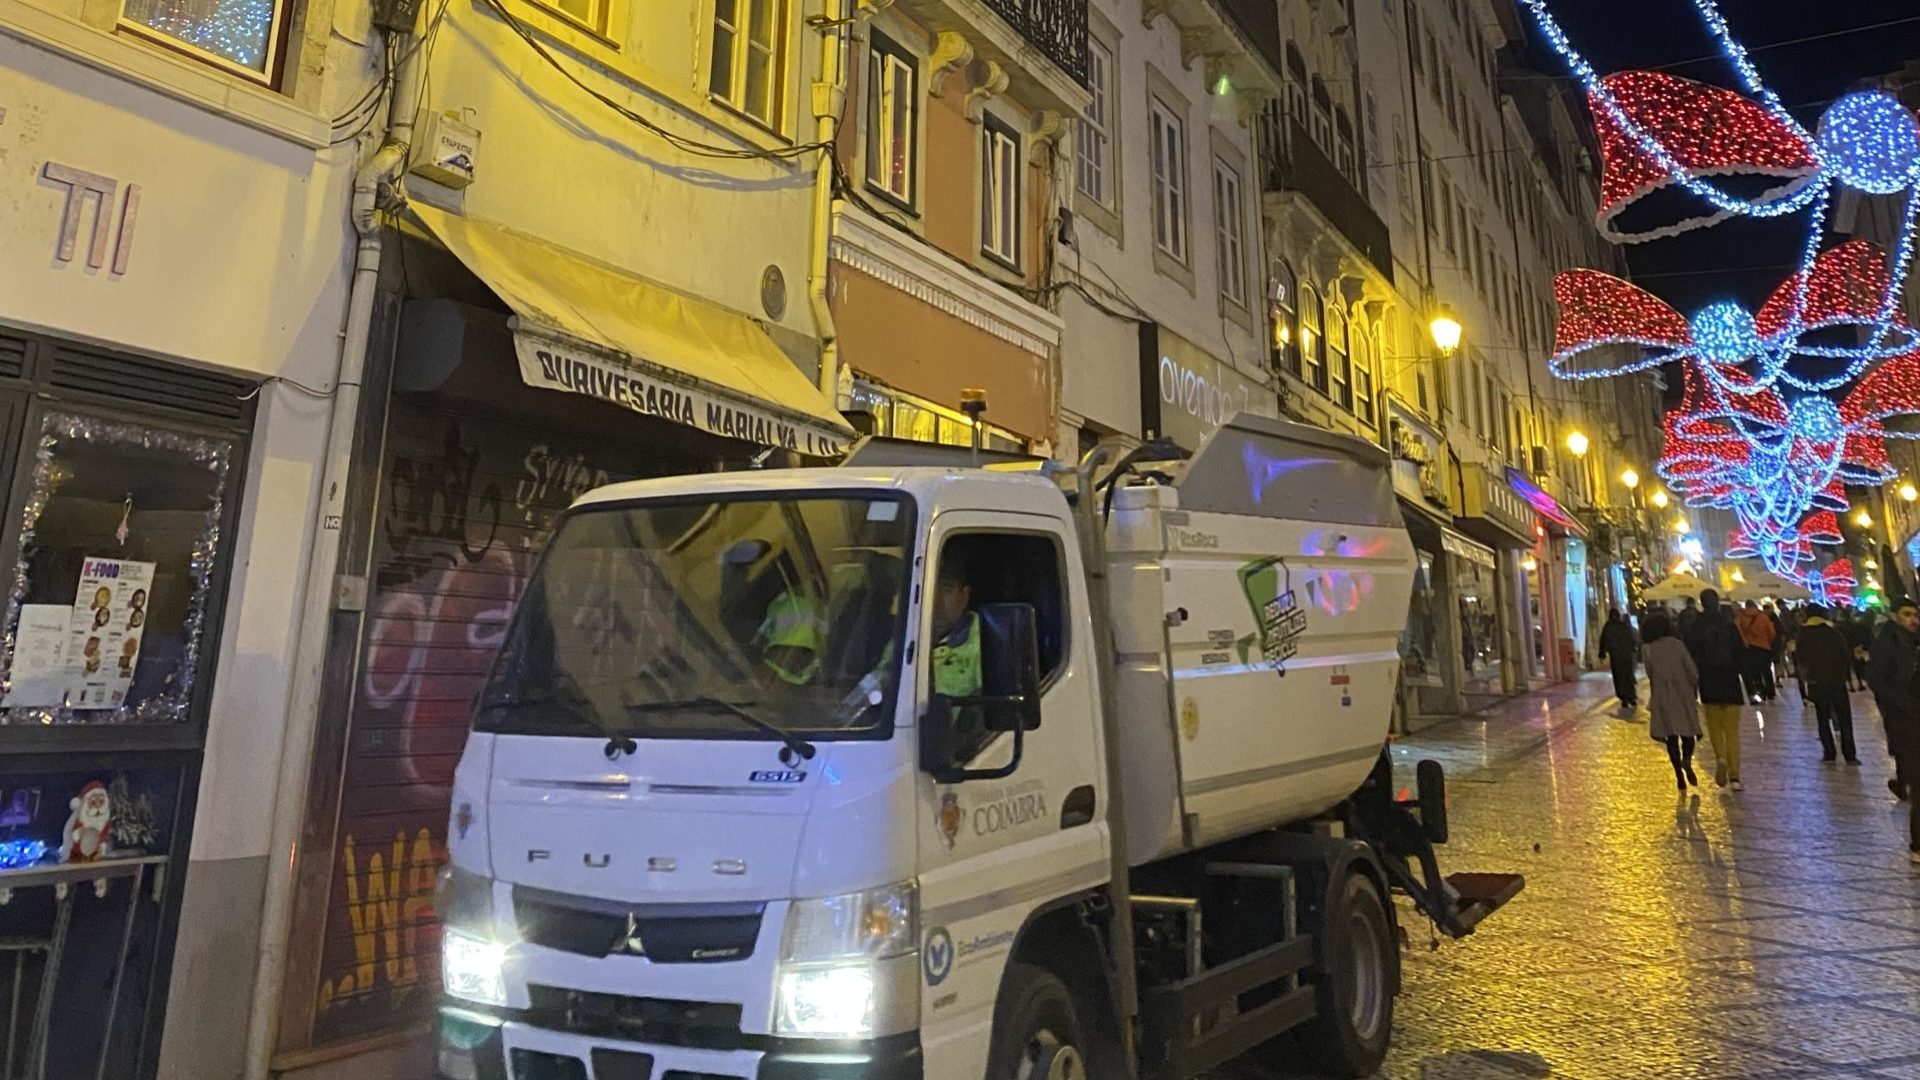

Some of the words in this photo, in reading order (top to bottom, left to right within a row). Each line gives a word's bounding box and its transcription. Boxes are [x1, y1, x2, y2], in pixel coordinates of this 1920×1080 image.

[537, 351, 696, 425] OURIVESARIA
[83, 561, 120, 579] K-FOOD
[974, 793, 1047, 836] COIMBRA
[528, 850, 747, 876] FUSO
